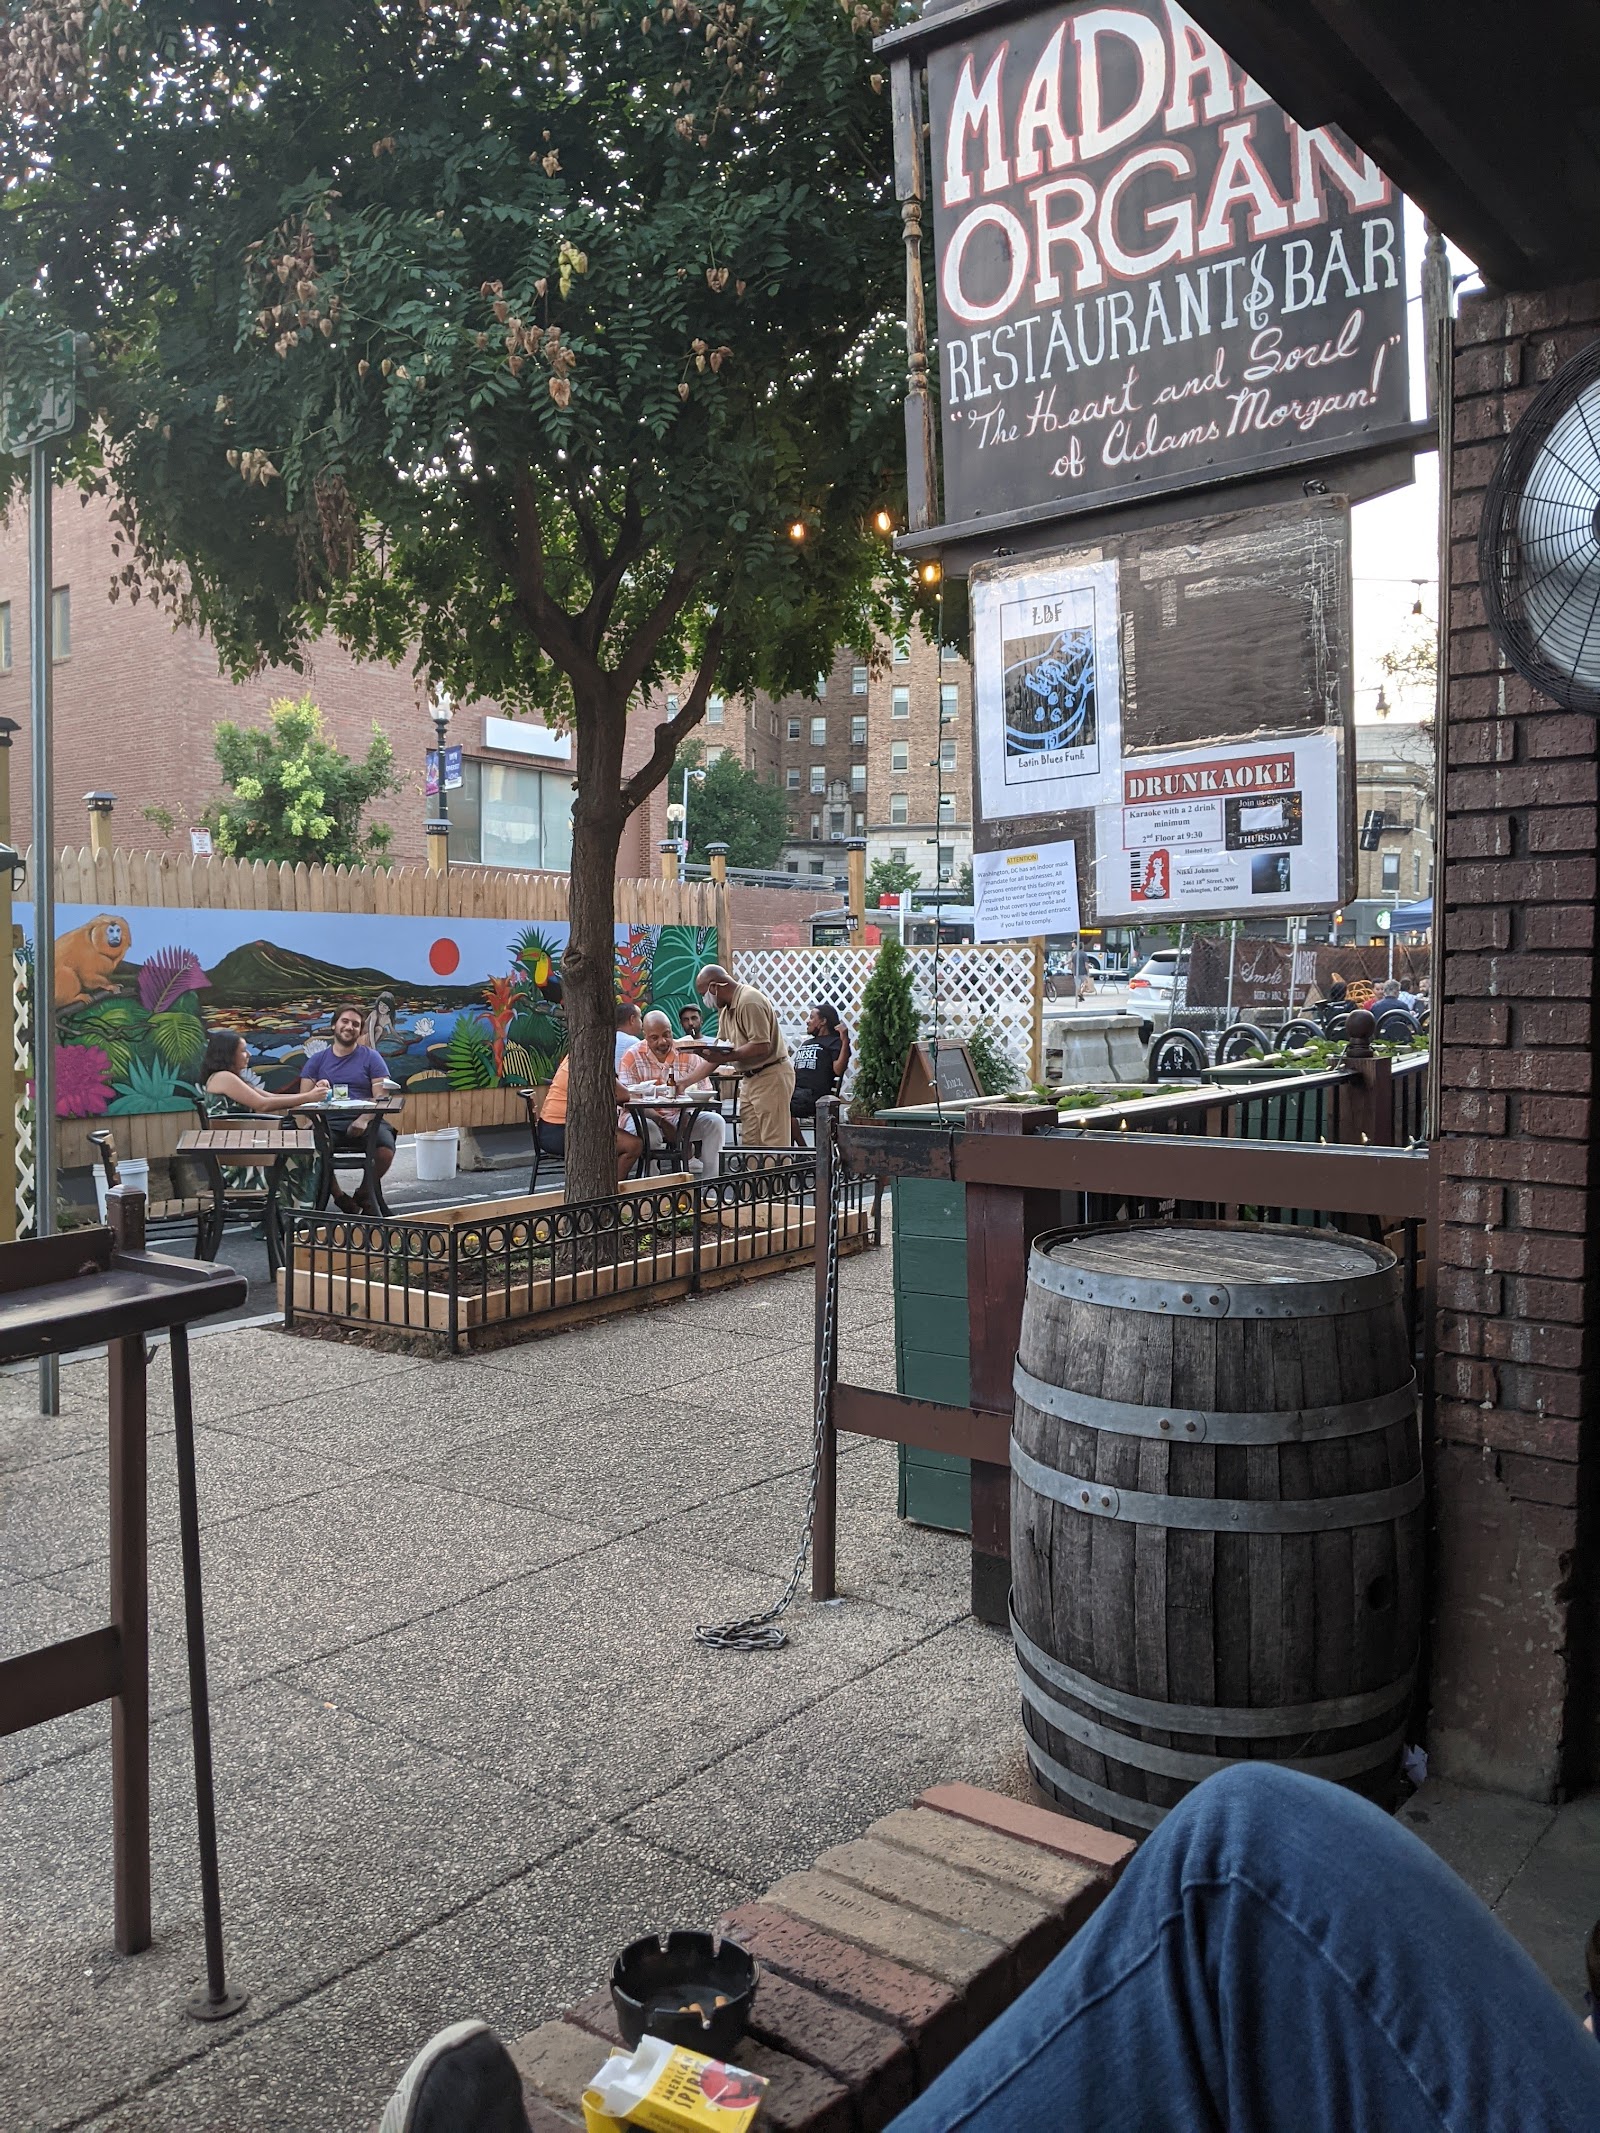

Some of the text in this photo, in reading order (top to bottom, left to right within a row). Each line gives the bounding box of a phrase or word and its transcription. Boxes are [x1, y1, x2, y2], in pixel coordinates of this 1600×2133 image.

[943, 0, 1275, 207] MADA
[942, 116, 1392, 323] ORGAN
[947, 256, 1246, 405] RESTAURANT
[1281, 217, 1398, 314] BAR
[1026, 365, 1142, 437] Heart
[1152, 347, 1231, 405] and
[1243, 309, 1363, 381] Soul
[1051, 435, 1085, 477] of
[1102, 413, 1220, 467] Adams
[1032, 599, 1064, 626] LBF
[1018, 749, 1086, 768] Latin Blues Funk
[1129, 762, 1291, 799] DRUNKAOKE
[1129, 809, 1161, 819] Karaoke
[1163, 807, 1180, 815] with
[1188, 805, 1193, 813] 2
[1194, 803, 1216, 812] drink
[1238, 799, 1254, 808] Join
[1154, 819, 1191, 828] minimum
[1155, 834, 1175, 842] Floor
[1186, 831, 1203, 839] 9:30
[1238, 832, 1290, 844] THURSDAY
[986, 878, 1008, 886] mandate
[1025, 873, 1054, 881] businesses.
[983, 887, 1004, 895] persons
[1005, 885, 1026, 893] entering
[983, 896, 1005, 904] required
[1048, 906, 1071, 914] entrance
[1031, 917, 1053, 925] comply.
[662, 2056, 695, 2101] AMERICAN
